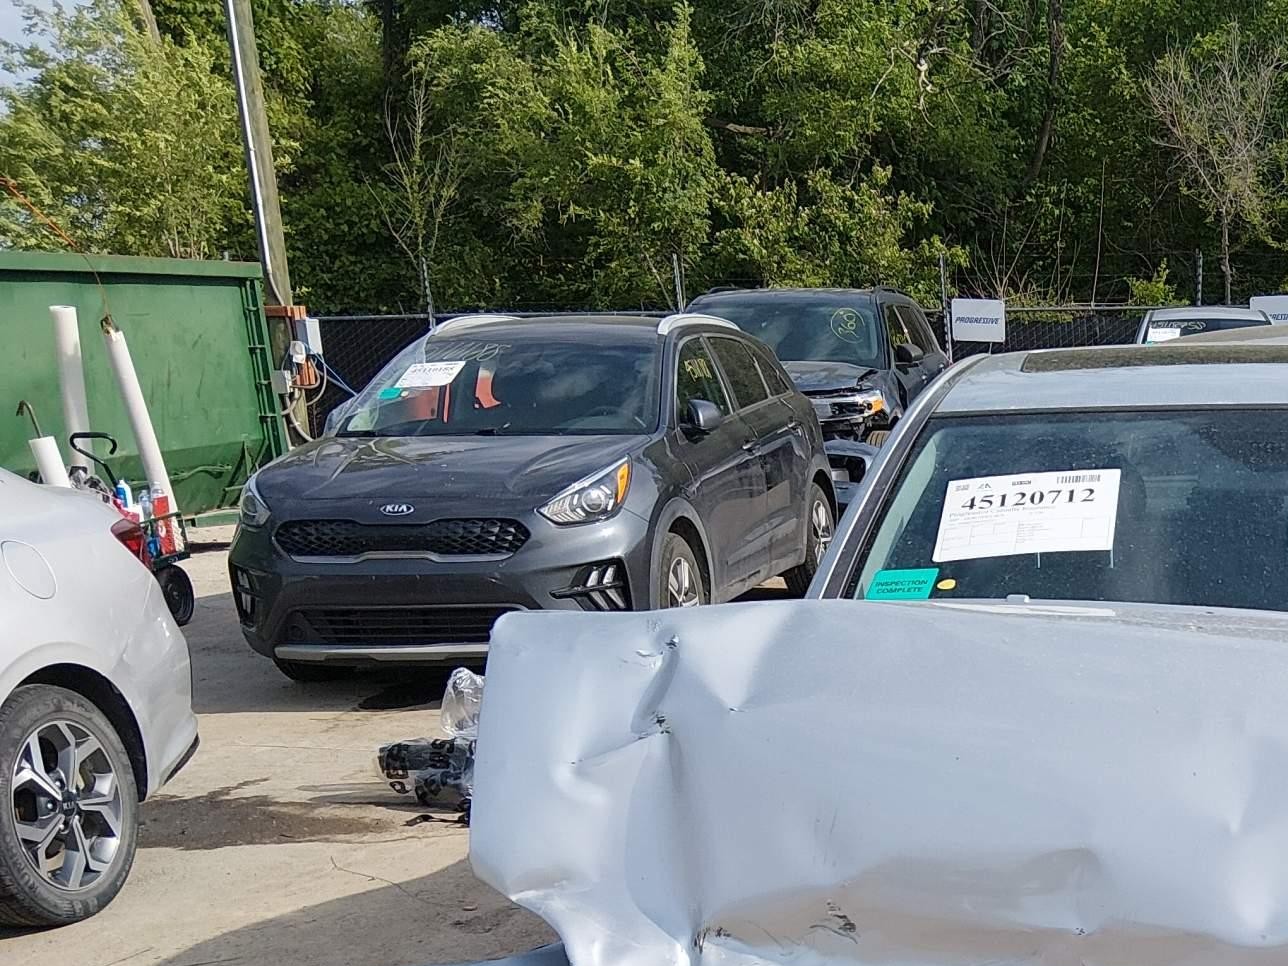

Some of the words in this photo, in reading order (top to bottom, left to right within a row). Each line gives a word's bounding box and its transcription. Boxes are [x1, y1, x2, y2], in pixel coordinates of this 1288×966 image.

[954, 316, 1000, 325] PROGRESSIVE
[960, 488, 1095, 511] 45120712
[875, 579, 928, 587] INSPECTION
[876, 586, 924, 594] COMPLETE
